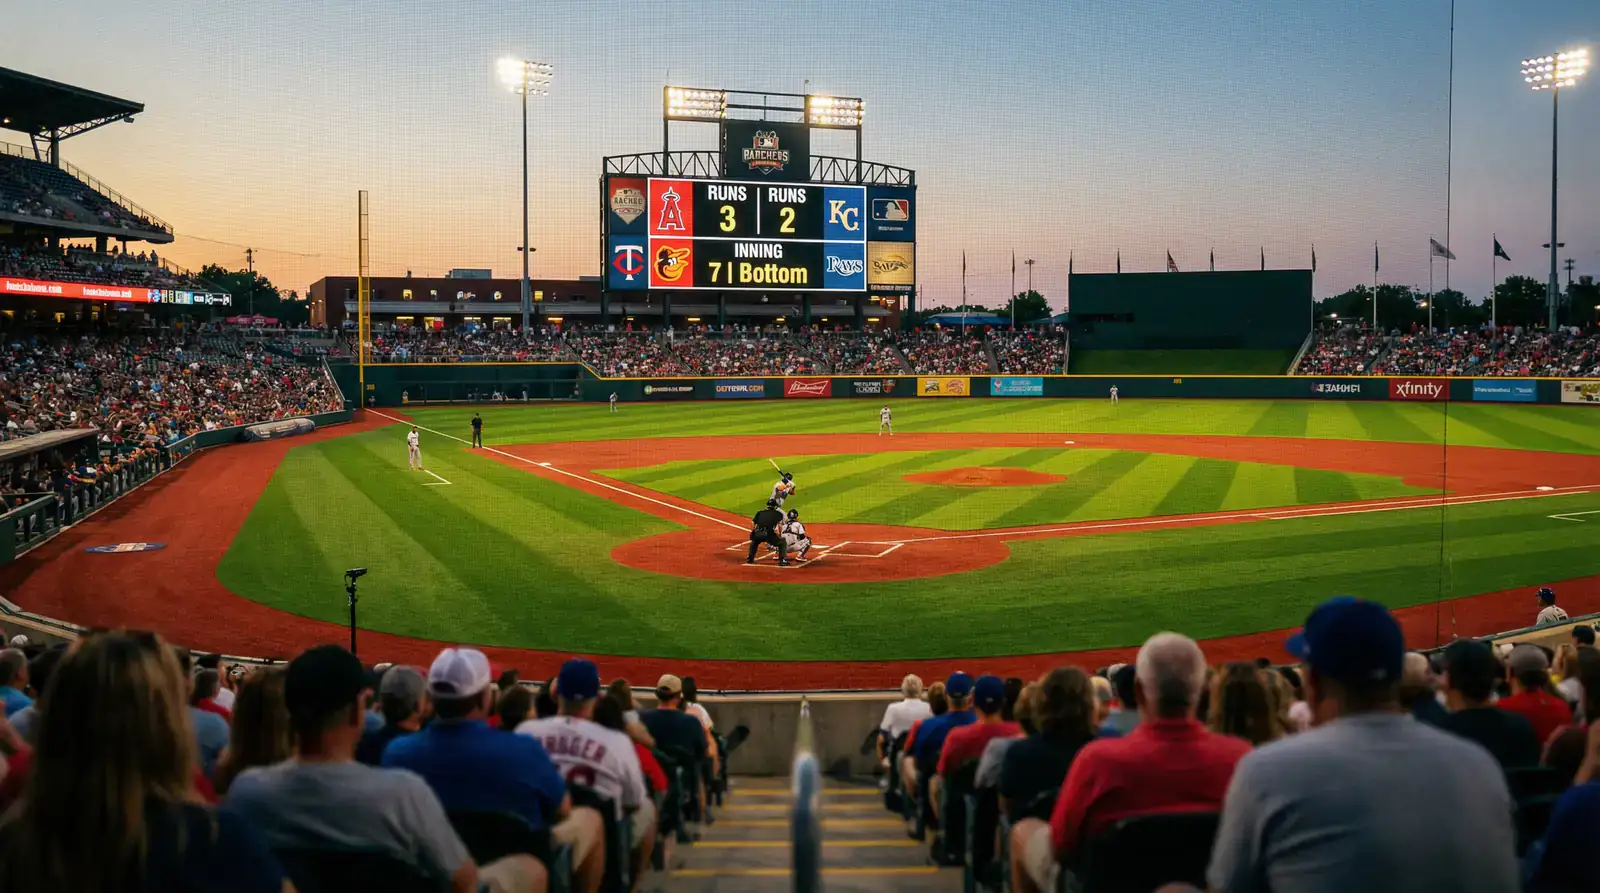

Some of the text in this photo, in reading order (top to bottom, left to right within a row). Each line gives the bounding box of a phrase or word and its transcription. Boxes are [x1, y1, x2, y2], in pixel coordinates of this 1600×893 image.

[708, 185, 747, 201] RUNS
[768, 187, 807, 203] RUNS
[657, 188, 685, 230] A
[719, 205, 736, 232] 3
[780, 207, 796, 233] 2
[829, 200, 859, 231] KC
[734, 243, 783, 259] INNING
[708, 262, 722, 283] 7
[739, 262, 808, 284] Bottom
[1396, 381, 1443, 398] xfinity
